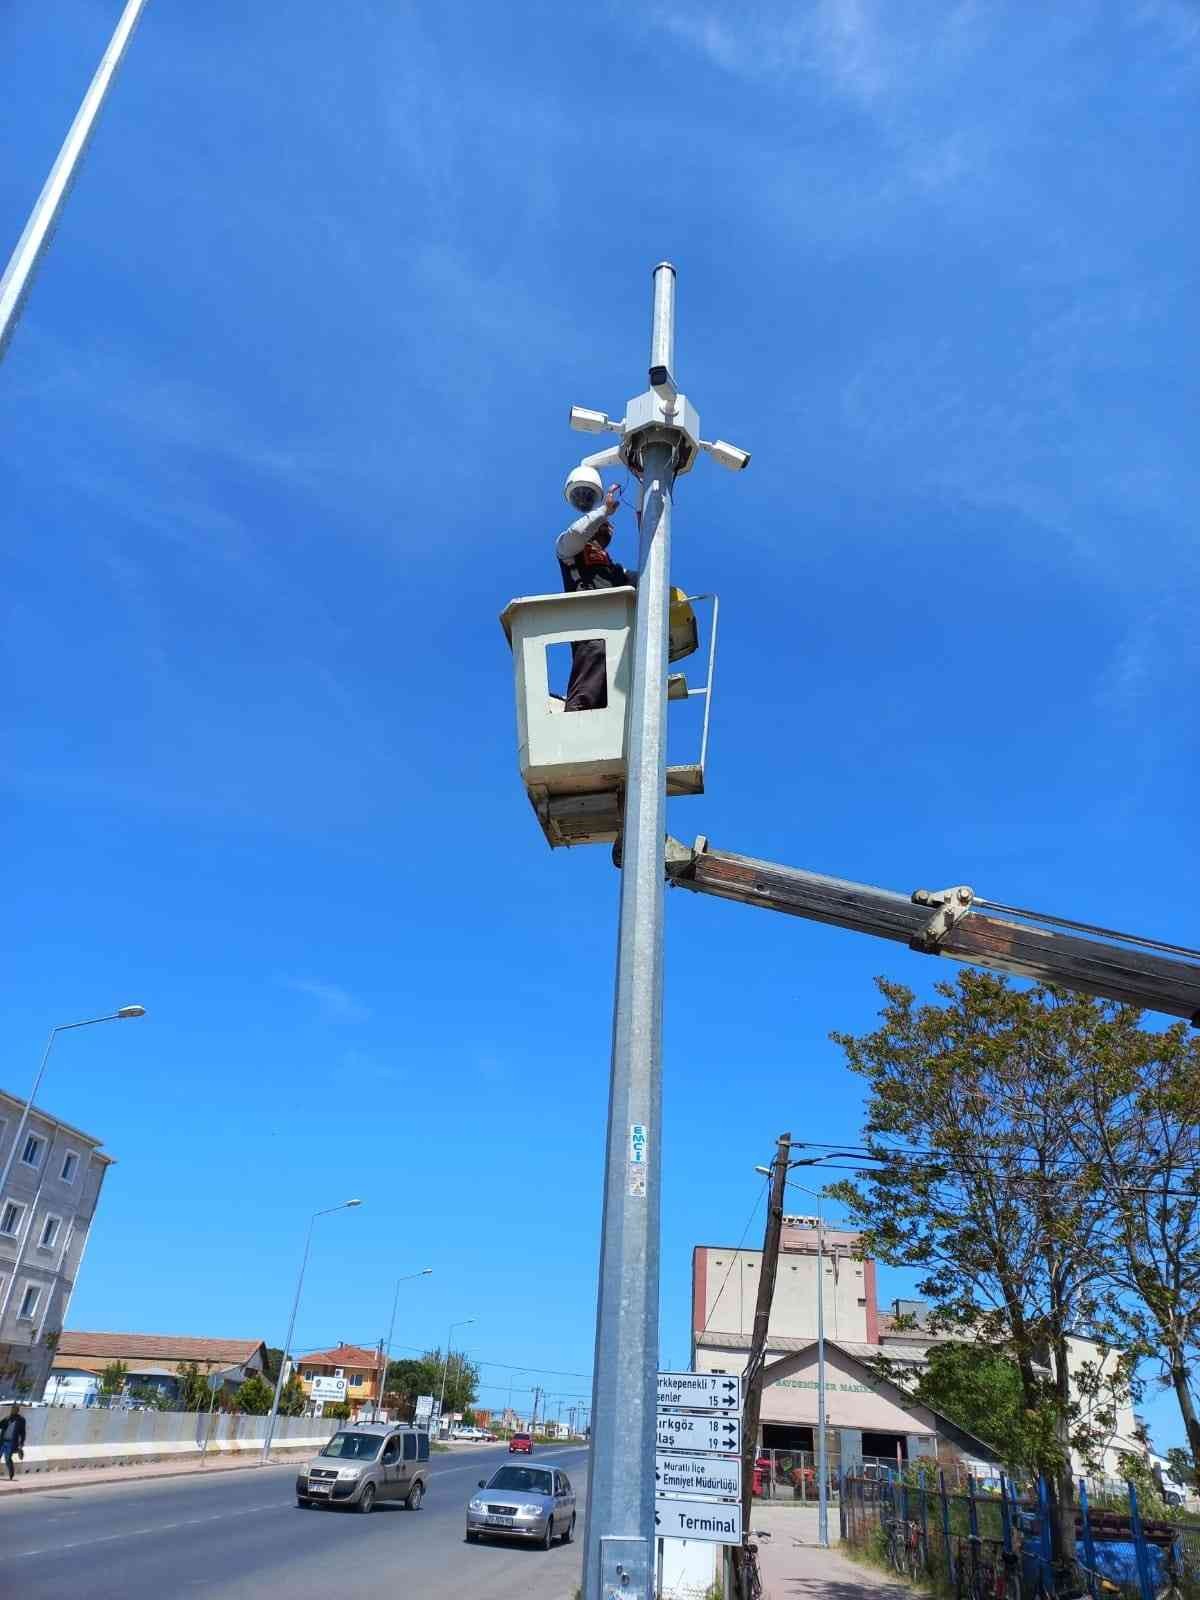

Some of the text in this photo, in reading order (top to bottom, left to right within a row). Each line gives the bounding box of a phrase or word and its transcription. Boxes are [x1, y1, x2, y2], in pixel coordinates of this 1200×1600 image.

[711, 1379, 716, 1389] 7
[656, 1392, 719, 1406] senler 15
[657, 1418, 719, 1432] ırkgöz 18
[657, 1432, 718, 1449] laş 19
[664, 1461, 690, 1472] Muratlı
[664, 1474, 737, 1493] Emniyet Müdürlüğü
[678, 1513, 736, 1533] Terminal
